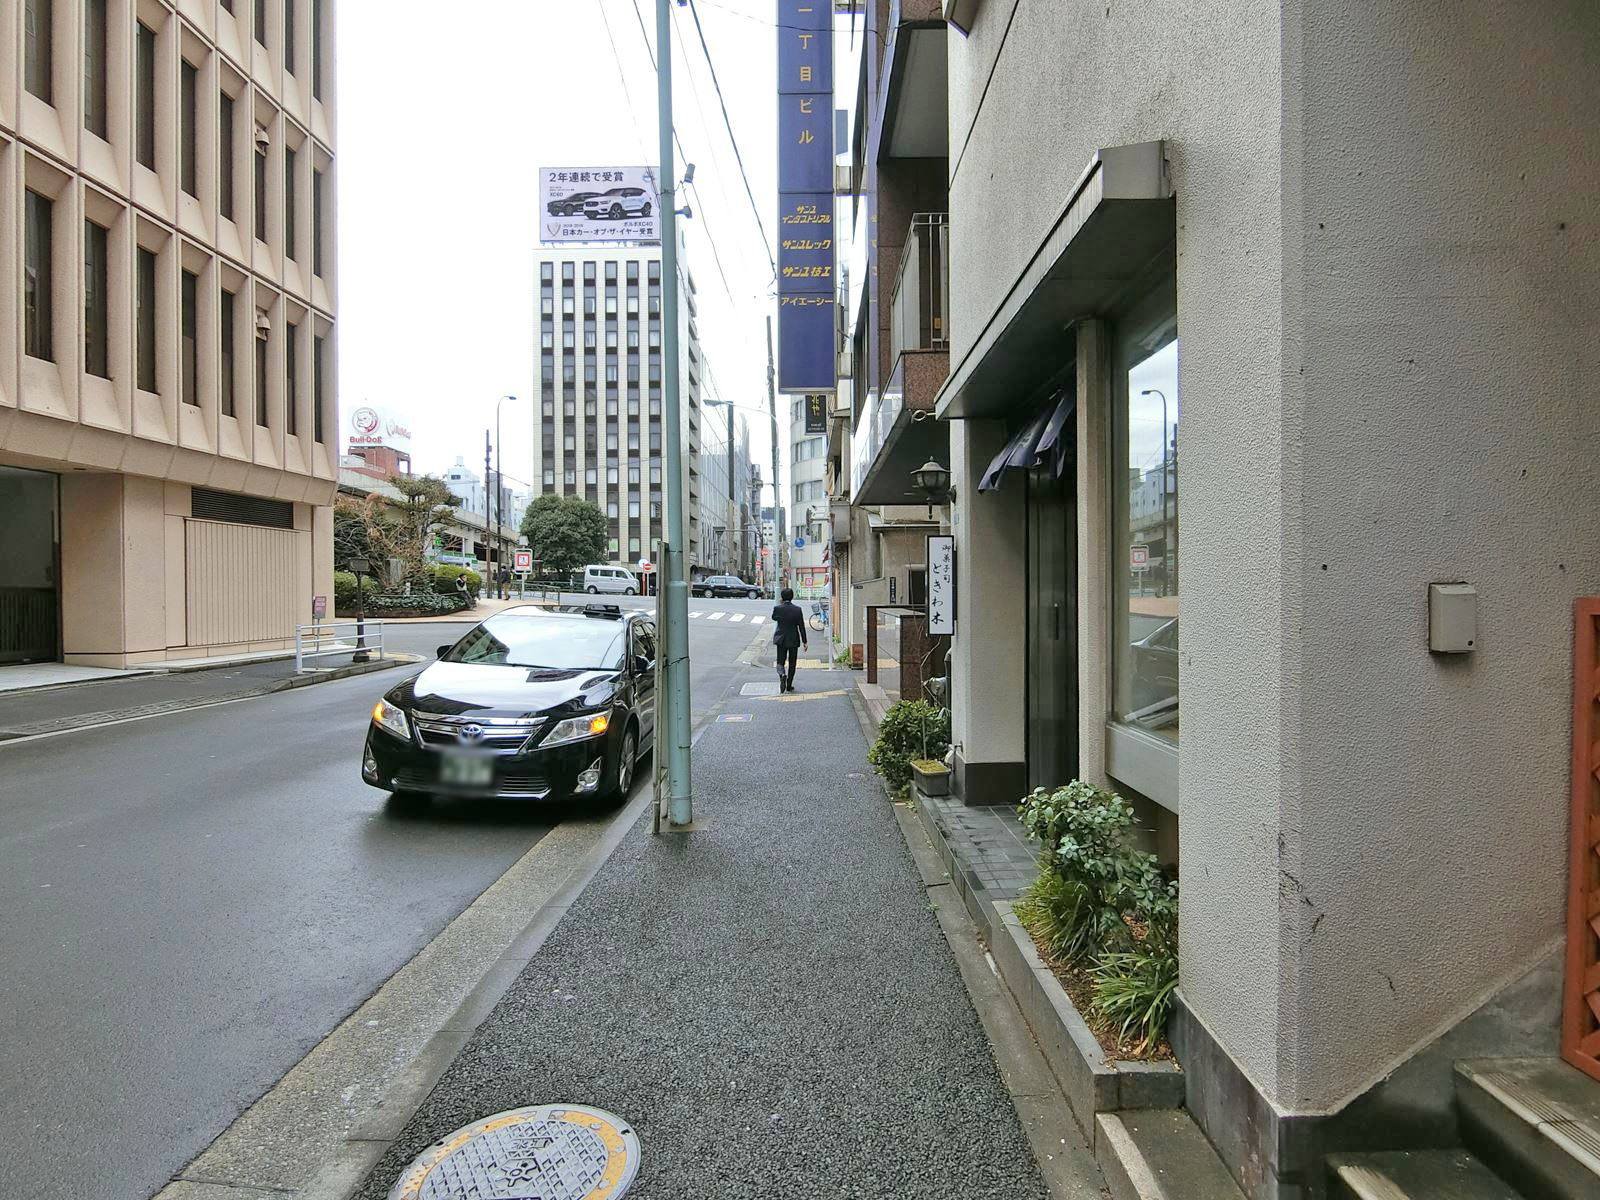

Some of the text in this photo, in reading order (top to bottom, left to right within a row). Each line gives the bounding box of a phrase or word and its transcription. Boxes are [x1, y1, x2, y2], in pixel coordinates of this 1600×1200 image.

[798, 8, 814, 144] 一丁目ビル
[549, 171, 624, 183] 2年連続で受賞
[781, 297, 833, 306] アイエーシー
[931, 563, 944, 625] ときわ木
